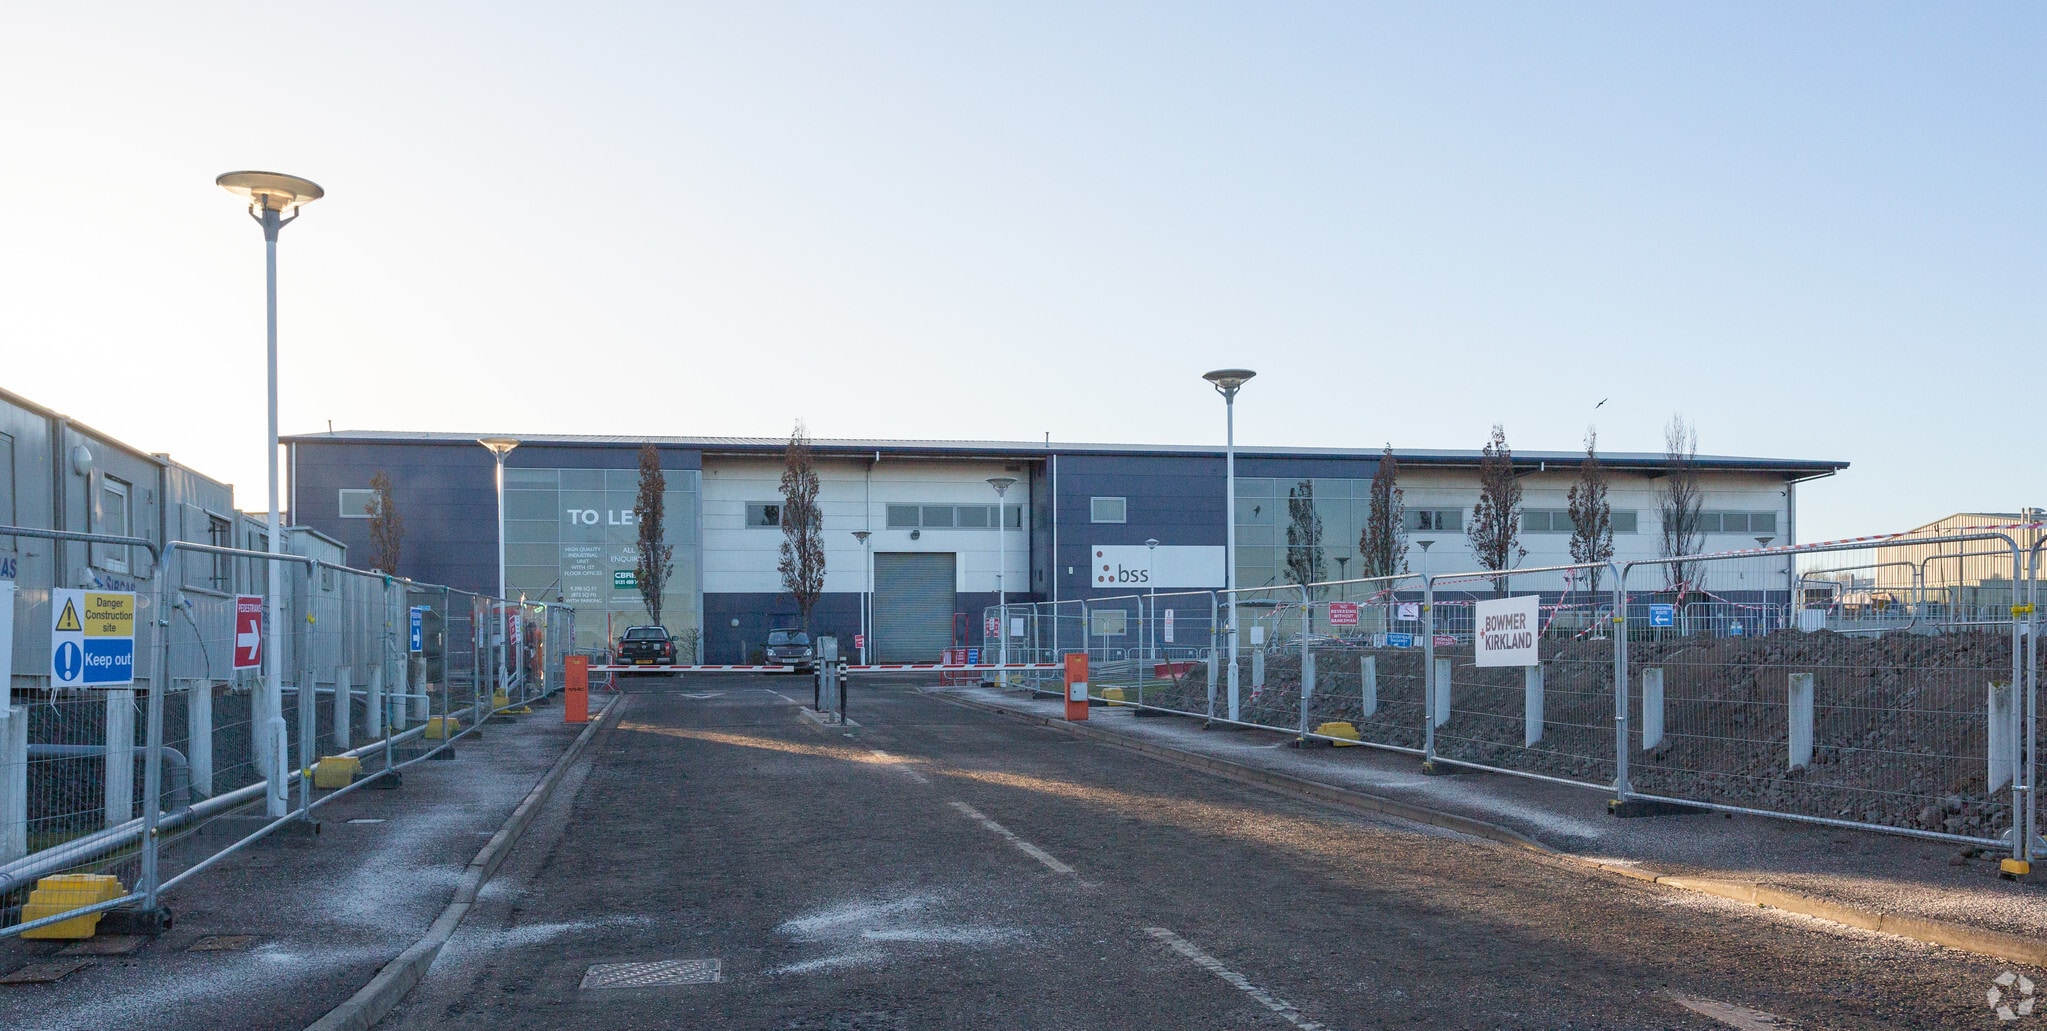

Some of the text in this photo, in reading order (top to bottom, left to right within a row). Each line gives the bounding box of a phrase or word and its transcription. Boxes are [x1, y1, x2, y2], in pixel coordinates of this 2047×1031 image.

[567, 509, 642, 525] TO LE
[1118, 563, 1149, 583] bss
[96, 597, 124, 610] Danger
[85, 609, 133, 621] Construction
[1485, 612, 1526, 632] BOWMER
[102, 623, 117, 633] site
[1485, 631, 1532, 651] KIRKLAND
[84, 652, 132, 669] Keep out
